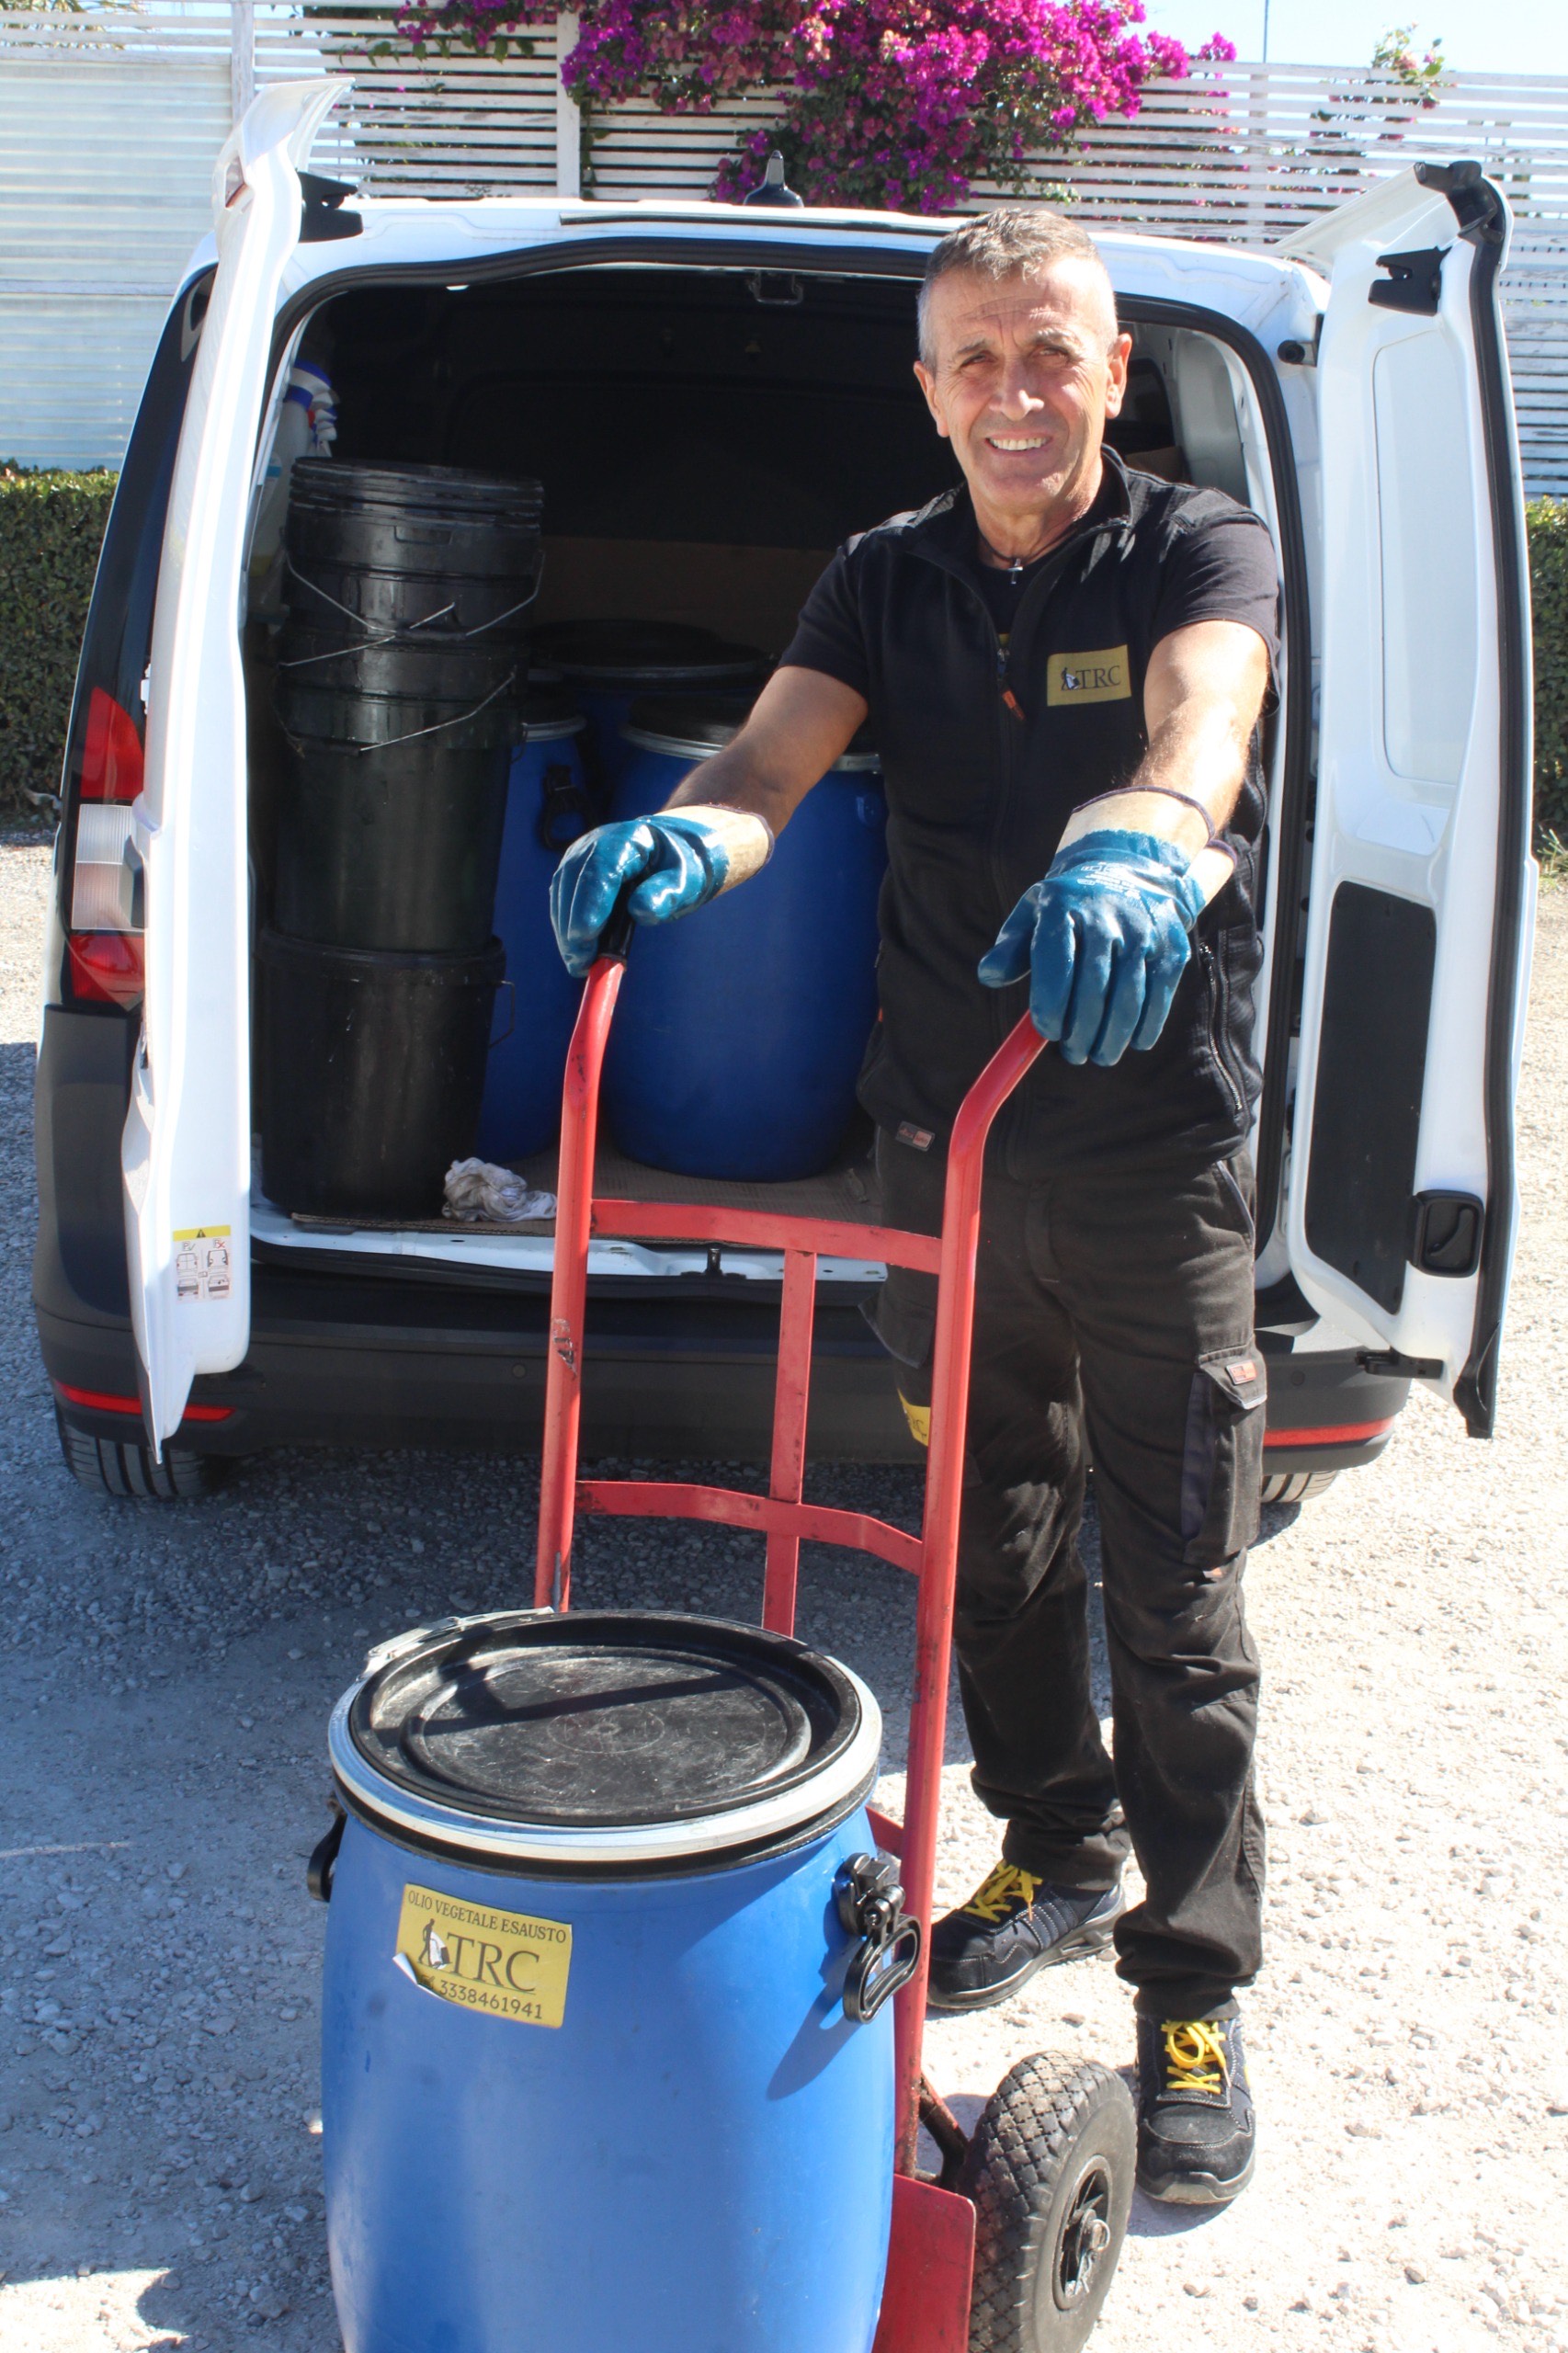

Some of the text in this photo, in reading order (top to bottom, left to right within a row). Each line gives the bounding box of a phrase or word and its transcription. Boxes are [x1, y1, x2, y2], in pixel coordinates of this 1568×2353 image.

[1075, 665, 1120, 689] TRC
[408, 1890, 566, 1944] OLIO VEGETALE ESAUSTO
[447, 1932, 540, 1992] TRC
[439, 1980, 542, 2020] 3338461941
